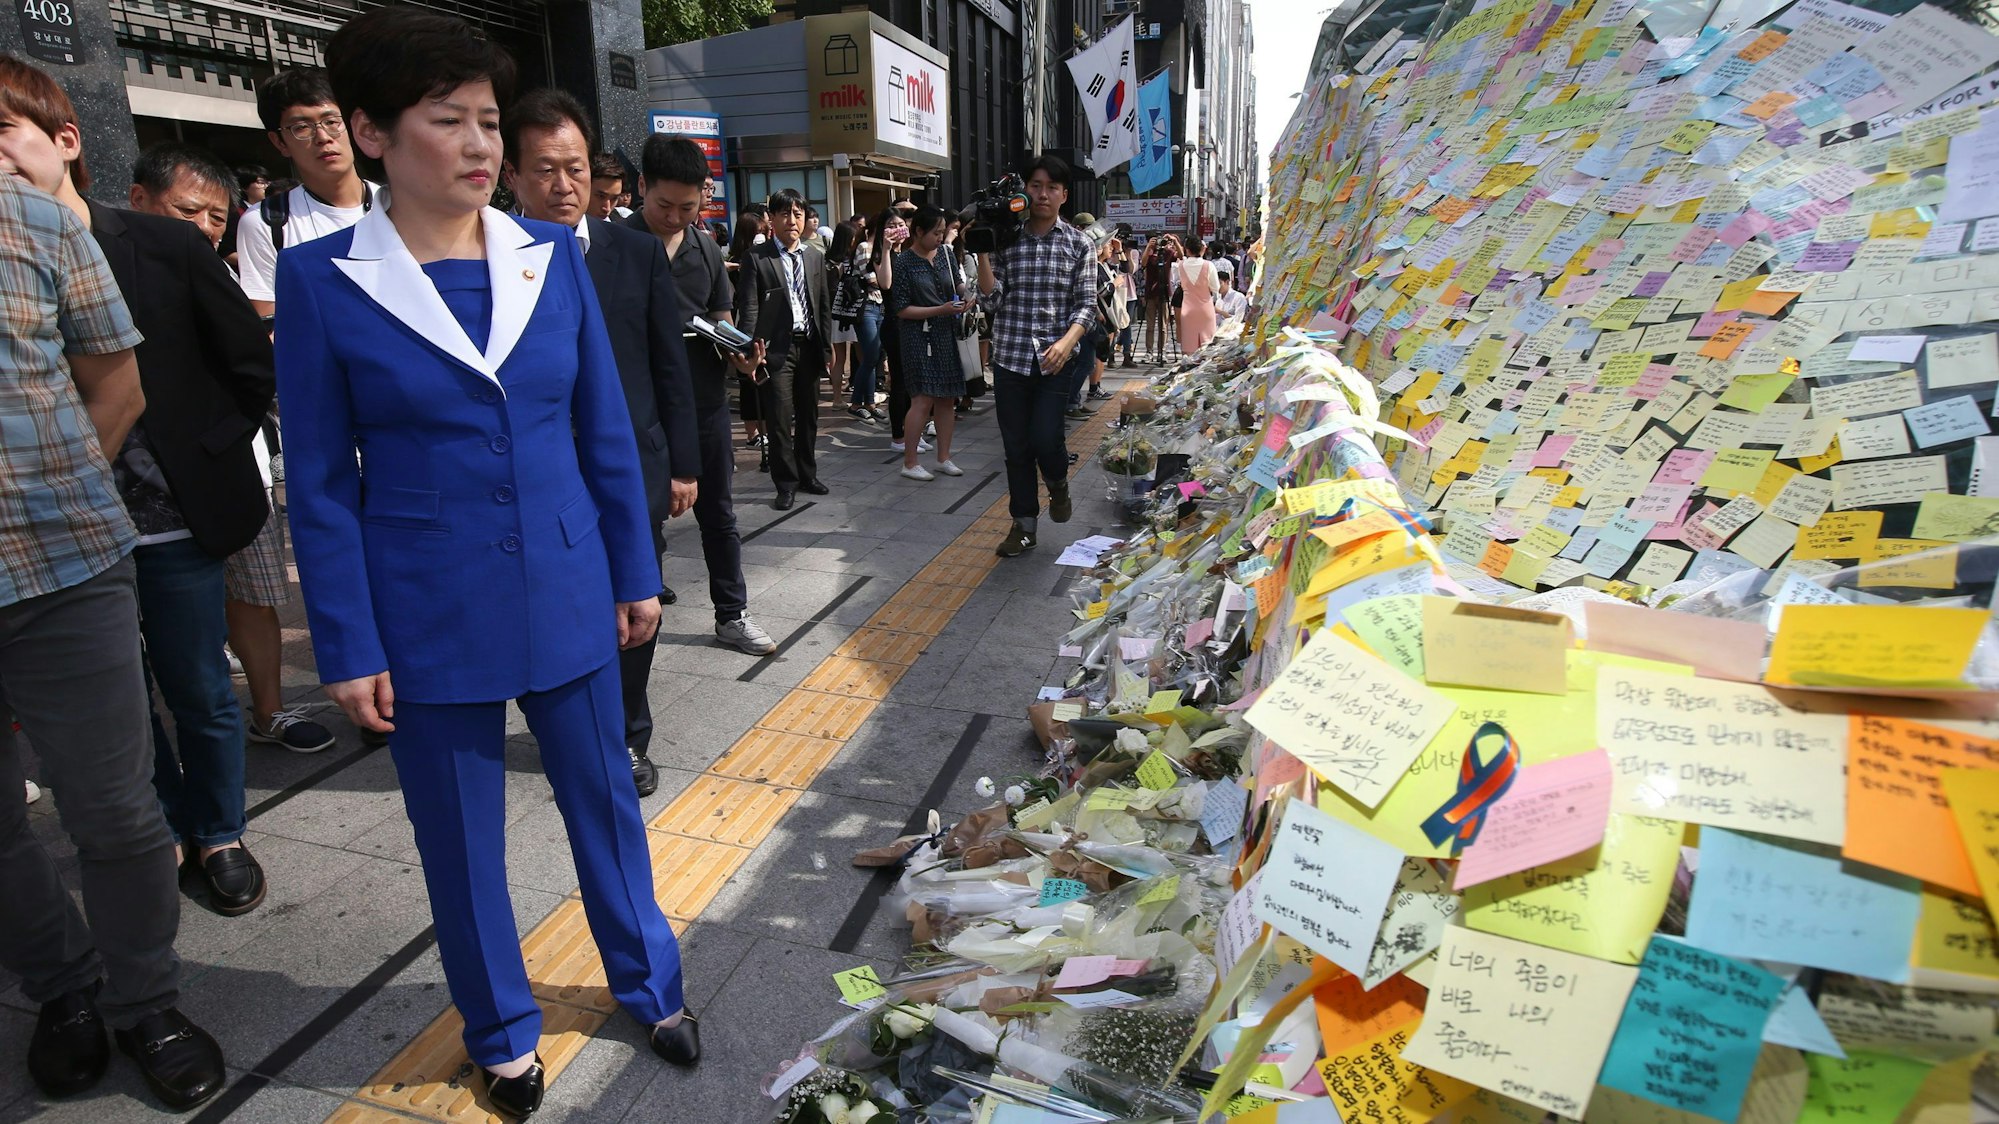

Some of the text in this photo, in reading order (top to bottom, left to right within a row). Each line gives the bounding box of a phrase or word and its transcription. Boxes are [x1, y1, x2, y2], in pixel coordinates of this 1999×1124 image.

[24, 0, 73, 26] 403
[34, 31, 72, 45] 강남대로
[820, 84, 867, 109] milk
[907, 68, 936, 116] milk
[1939, 86, 1983, 111] FOR
[665, 118, 719, 133] 강남플란트치과
[1138, 200, 1187, 214] 유학닷컴
[1448, 944, 1579, 997] 너의 죽음이
[1440, 985, 1555, 1027] 바로 나의
